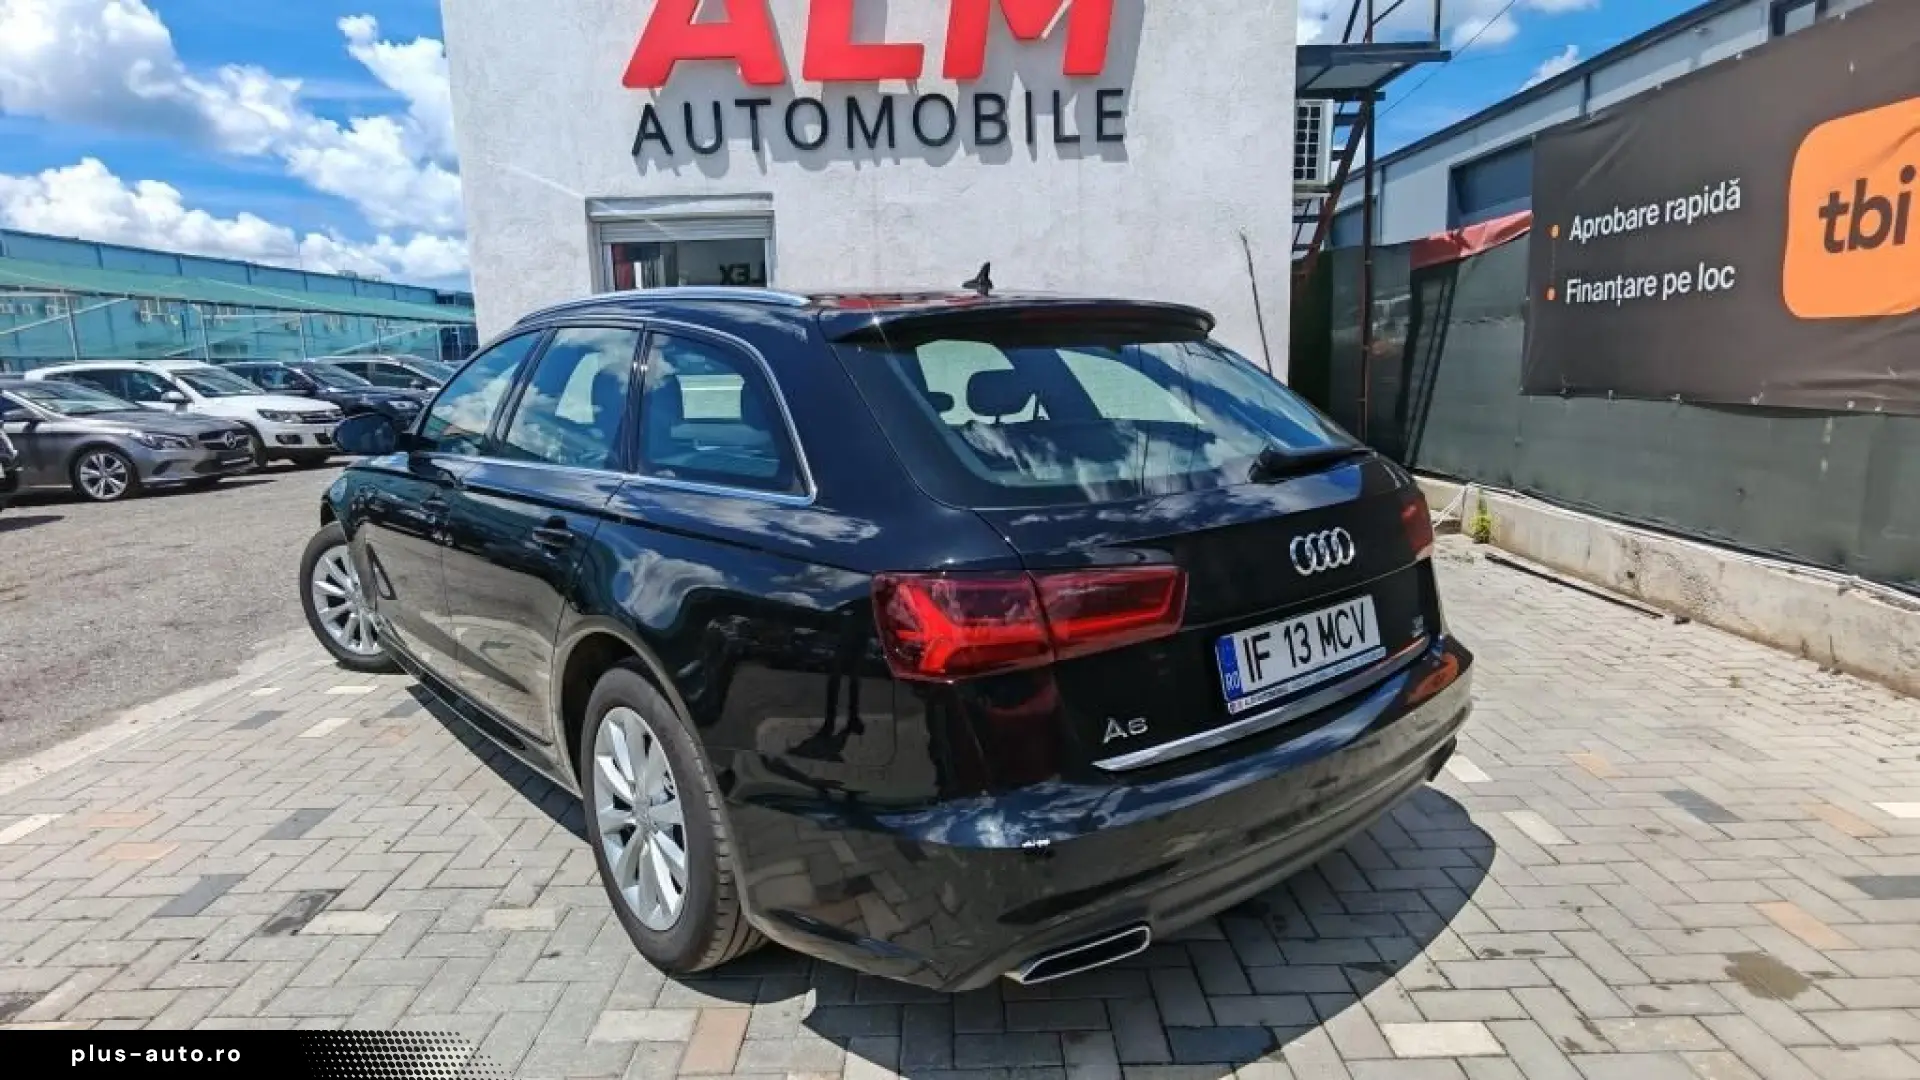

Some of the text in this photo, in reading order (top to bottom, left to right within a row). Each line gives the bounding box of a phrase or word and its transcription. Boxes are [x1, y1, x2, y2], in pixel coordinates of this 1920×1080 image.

[631, 89, 1125, 156] AUTOMOBILE
[1568, 177, 1742, 244] Aprobare rapidă
[1818, 164, 1917, 254] tbi
[1662, 270, 1692, 301] pe
[1697, 262, 1736, 293] loc
[1243, 631, 1272, 683] IF
[1284, 622, 1312, 668] 13
[1316, 602, 1366, 657] MCV
[1103, 716, 1149, 745] A6
